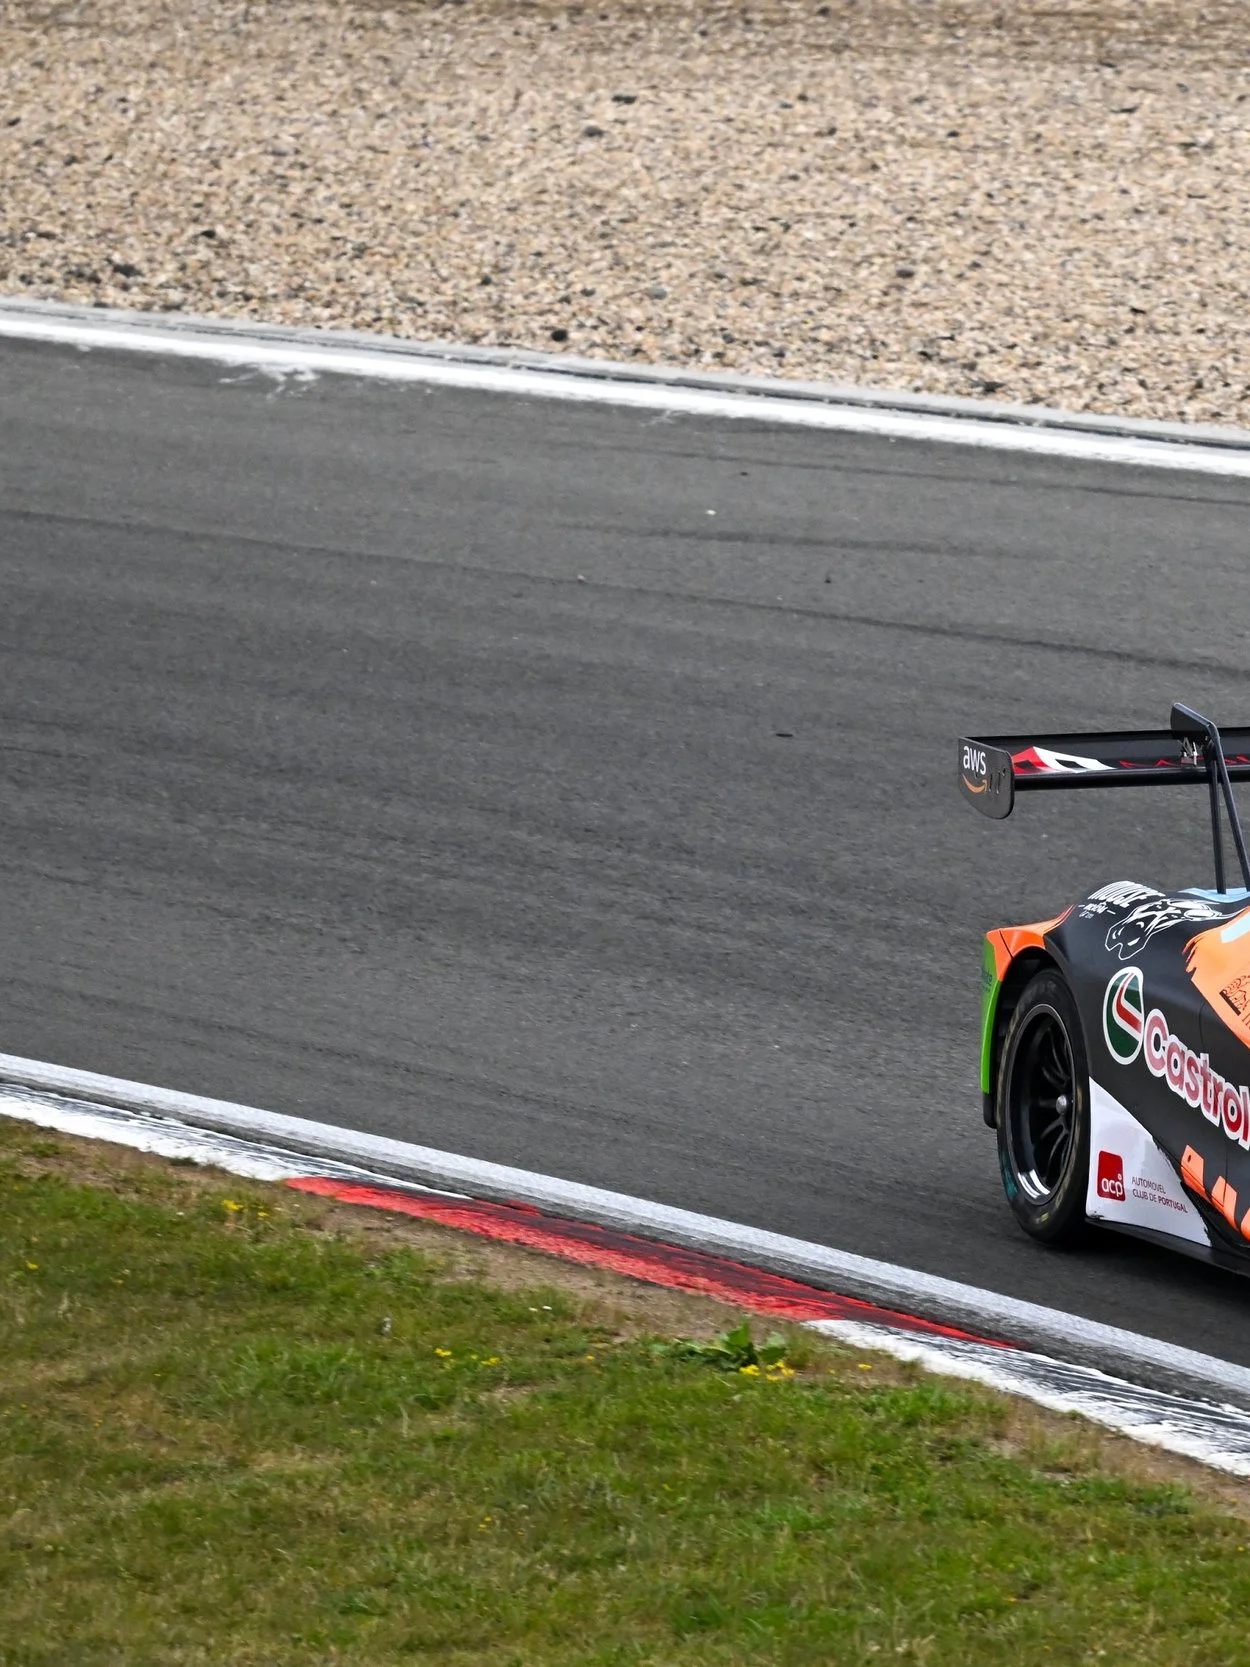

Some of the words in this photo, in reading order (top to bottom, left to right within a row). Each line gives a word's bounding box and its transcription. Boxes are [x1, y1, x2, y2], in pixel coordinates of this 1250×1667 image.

[963, 745, 987, 775] aws
[1101, 1177, 1124, 1198] acp
[1132, 1188, 1149, 1201] CLUB
[1149, 1193, 1158, 1203] DE
[1157, 1195, 1189, 1214] PORTUGAL
